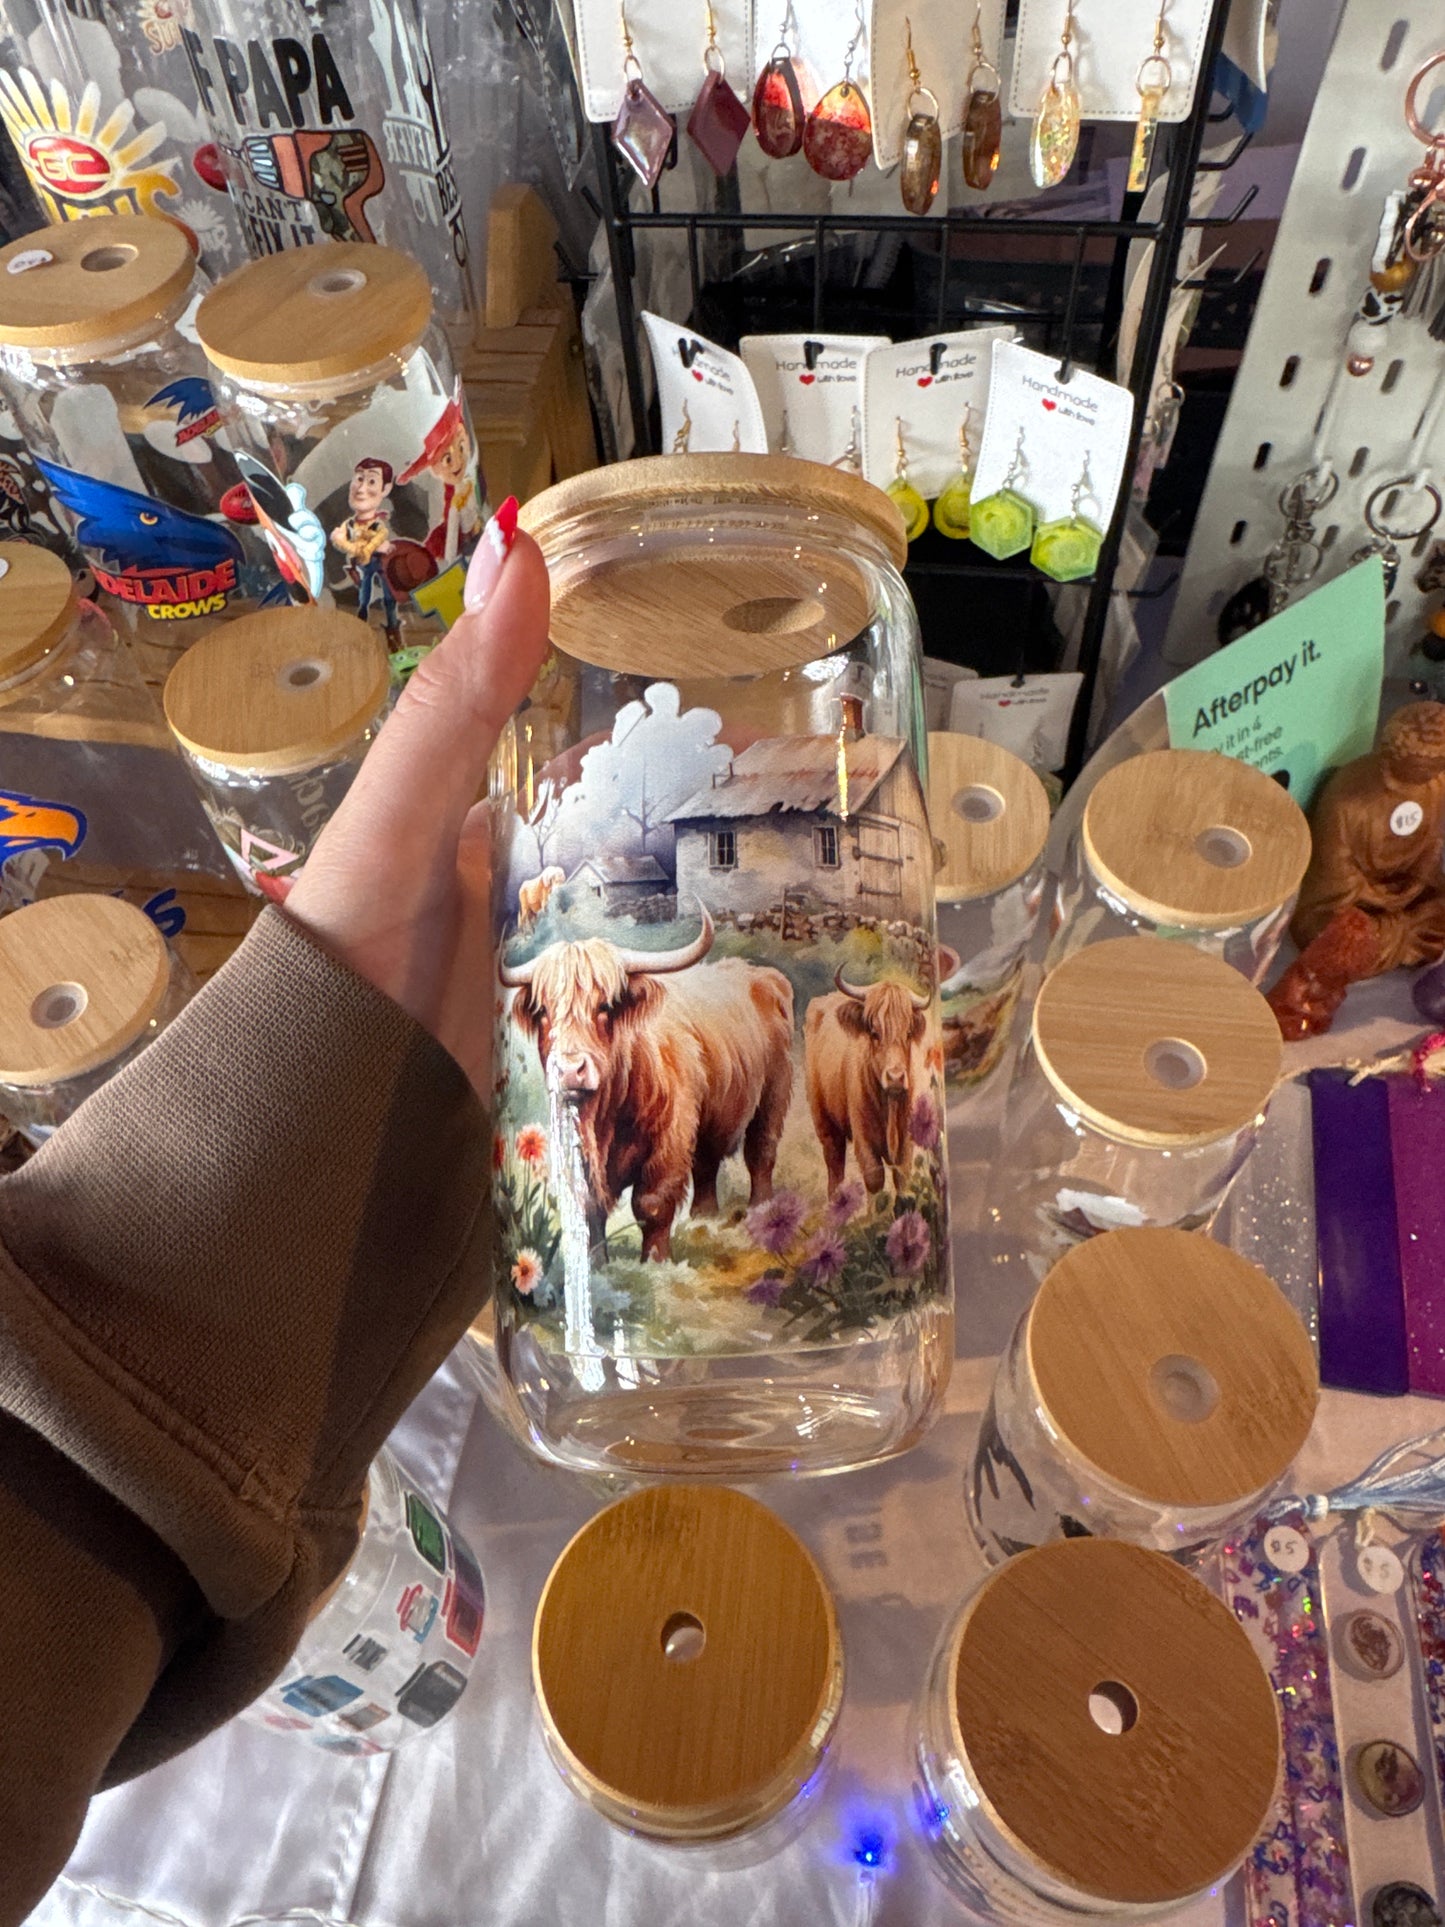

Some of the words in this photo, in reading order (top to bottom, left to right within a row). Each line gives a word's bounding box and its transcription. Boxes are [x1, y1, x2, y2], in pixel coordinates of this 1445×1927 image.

[145, 21, 181, 54] SU
[213, 34, 355, 129] PAPA
[243, 191, 301, 221] CAN'T
[290, 223, 315, 247] IT
[776, 358, 857, 371] Hanmade
[1022, 375, 1098, 413] Handmade
[147, 593, 226, 620] CROWS
[1192, 653, 1298, 738] Afterpay
[1302, 640, 1321, 667] it.
